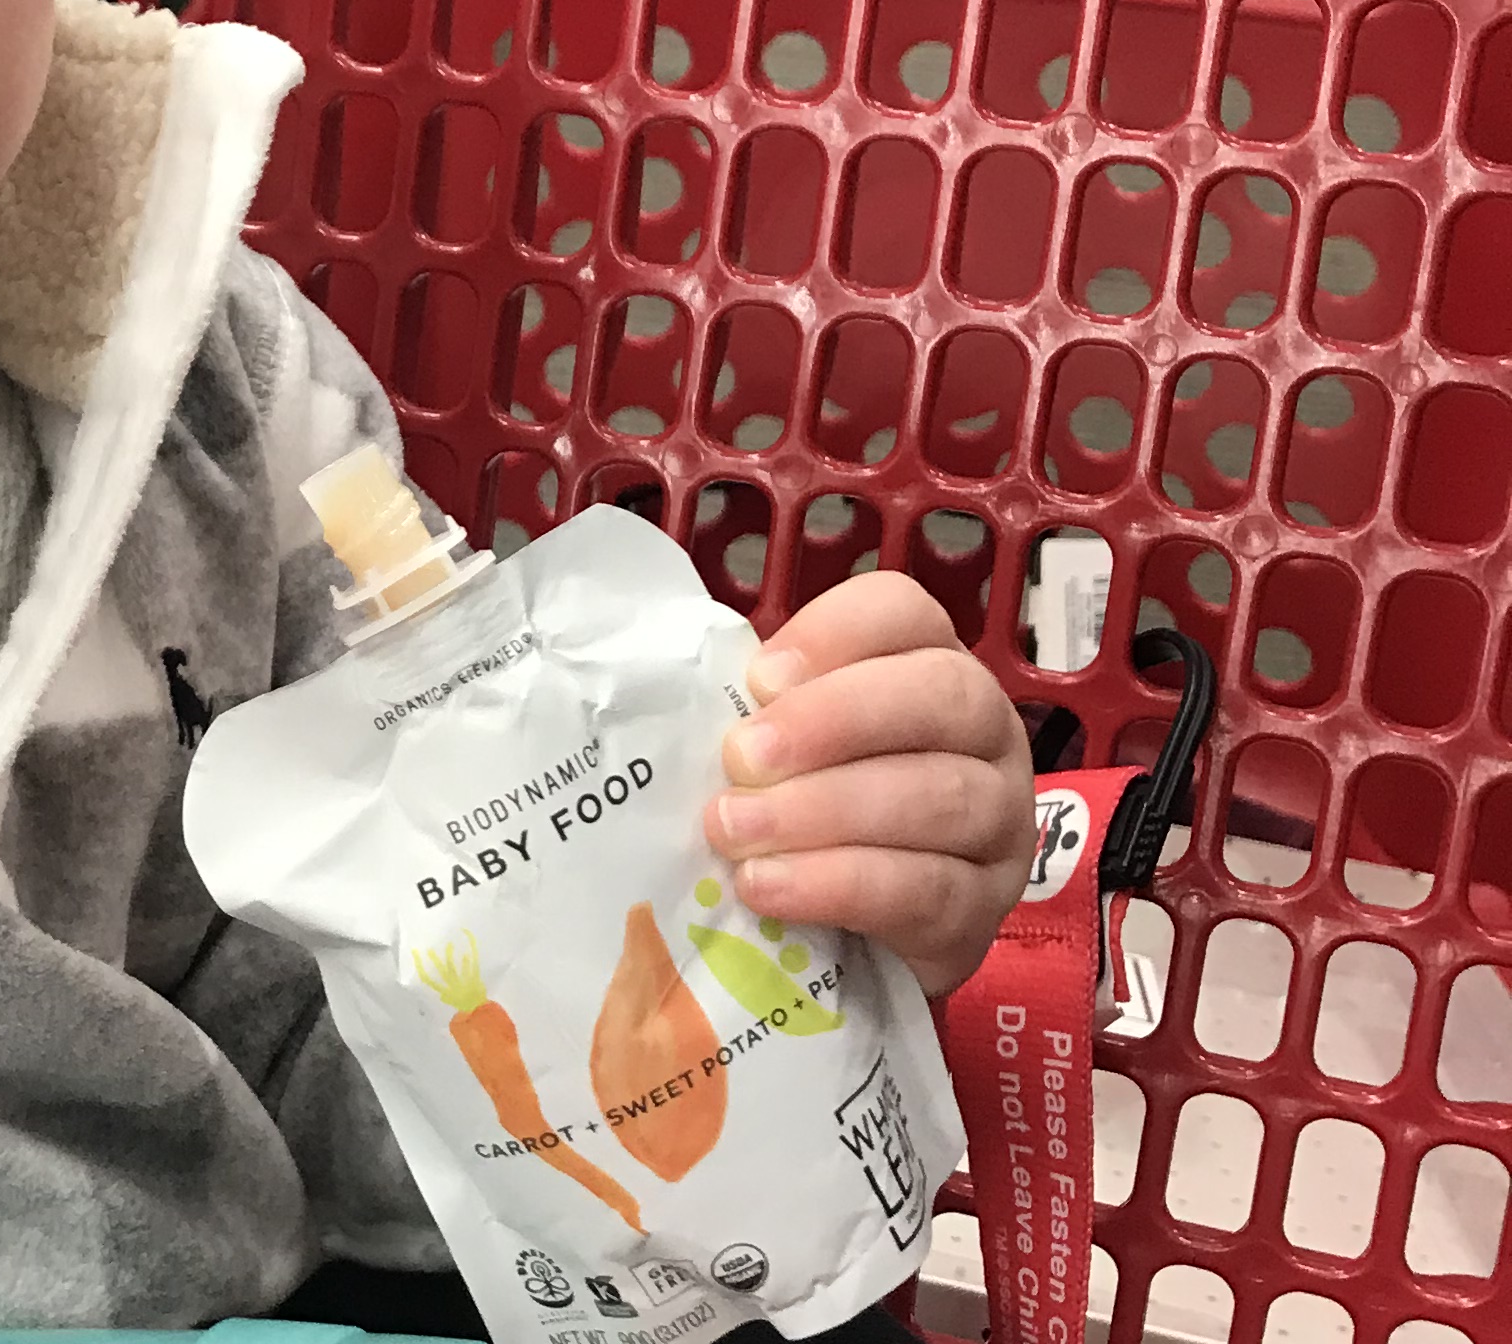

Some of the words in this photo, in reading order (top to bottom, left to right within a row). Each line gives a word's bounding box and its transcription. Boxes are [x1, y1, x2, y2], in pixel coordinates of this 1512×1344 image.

[373, 682, 452, 731] ORGANICS
[723, 684, 752, 718] ADULT
[416, 829, 531, 908] BABY
[550, 757, 653, 842] FOOD
[474, 1124, 574, 1159] CARROT
[605, 1068, 694, 1127] SWEET
[700, 1007, 789, 1077] POTATO
[808, 963, 844, 1000] PEA
[996, 1005, 1026, 1059] Do
[999, 1071, 1032, 1133] not
[1042, 1029, 1073, 1160] Please
[1008, 1142, 1034, 1254] Leave
[1049, 1171, 1076, 1303] Fasten
